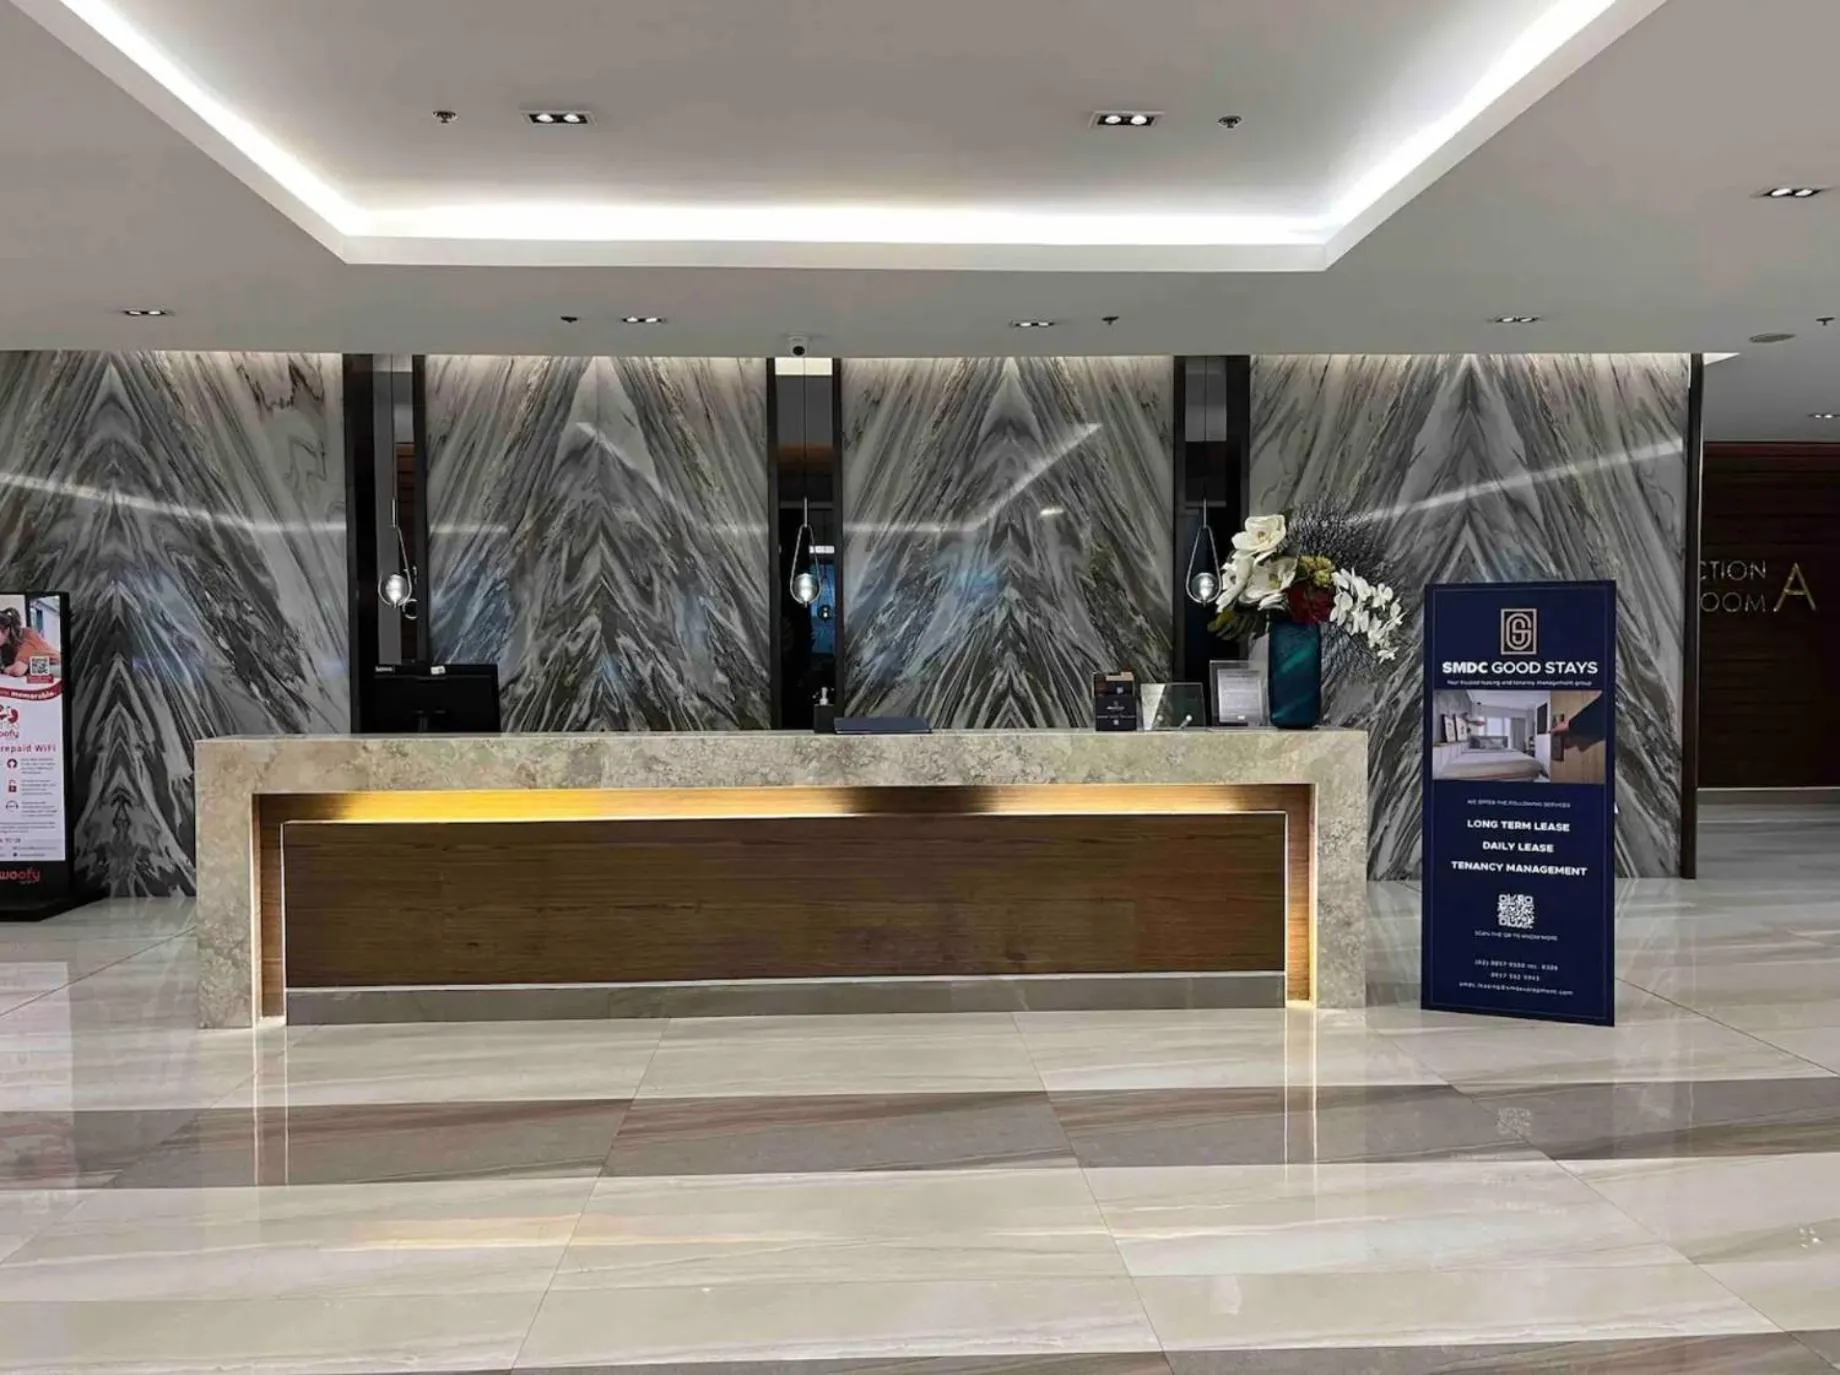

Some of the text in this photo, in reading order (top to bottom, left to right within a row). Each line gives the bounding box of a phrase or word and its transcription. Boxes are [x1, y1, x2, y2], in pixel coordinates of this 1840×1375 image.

[1773, 562, 1817, 613] A
[1442, 661, 1598, 674] SMDC GOOD STAYS
[1467, 819, 1570, 832] LONG TERM LEASE
[1482, 841, 1554, 853] DAILY LEASE
[1451, 861, 1588, 876] TENANCY MANAGEMENT
